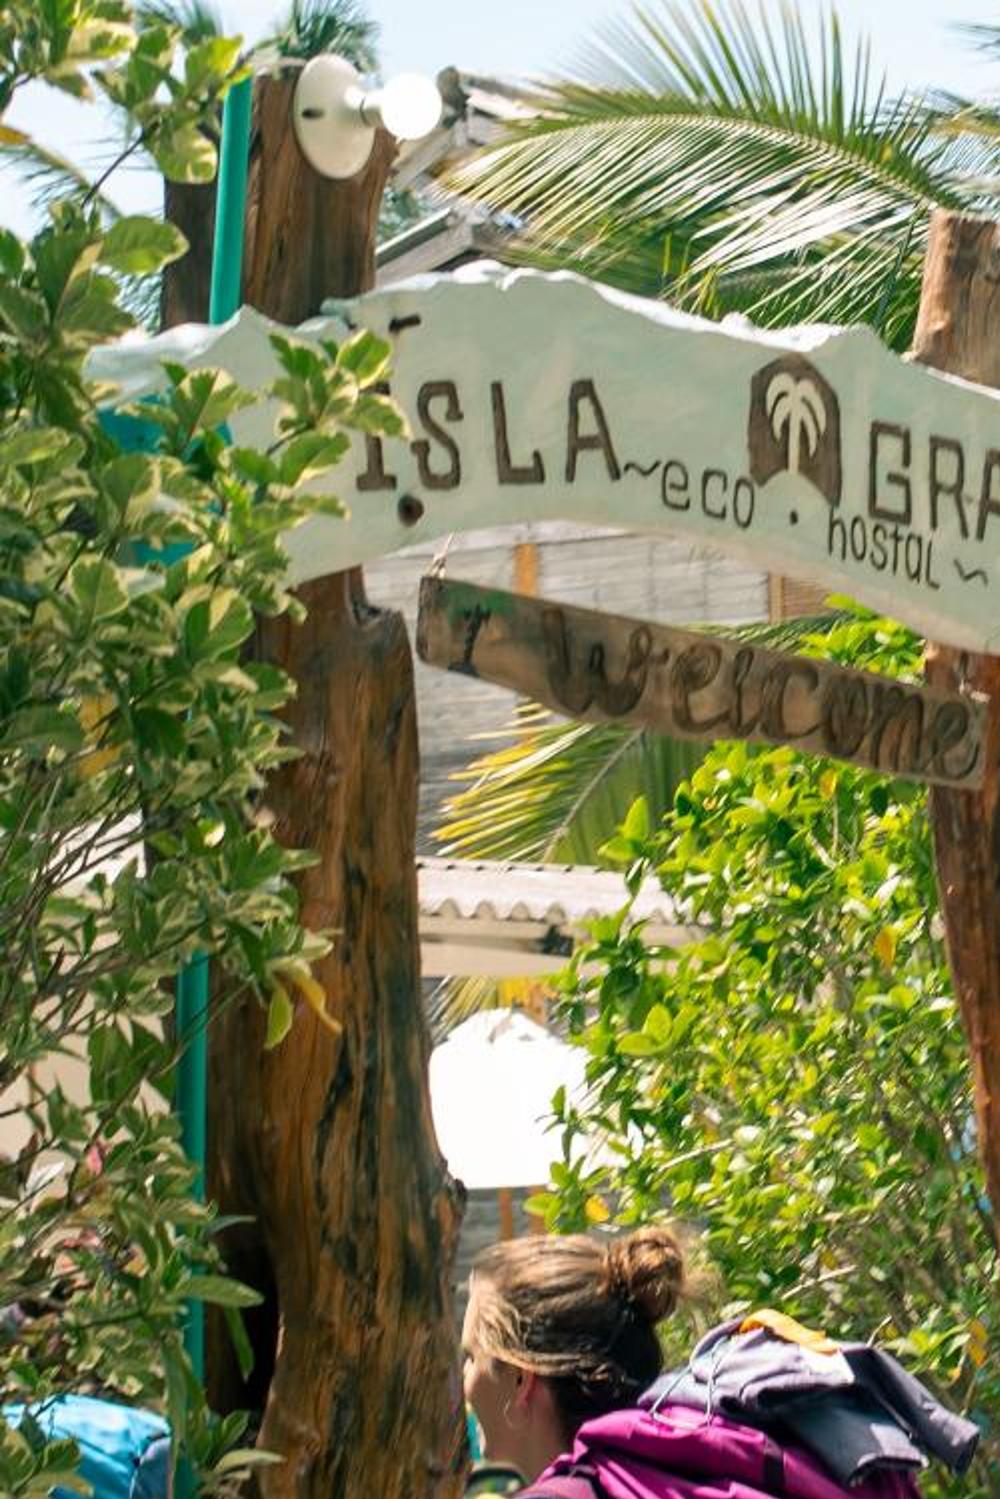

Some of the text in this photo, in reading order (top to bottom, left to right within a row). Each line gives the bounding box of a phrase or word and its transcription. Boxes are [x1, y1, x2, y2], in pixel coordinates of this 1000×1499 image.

[356, 378, 621, 492] ISLA
[660, 458, 941, 591] eco hostal
